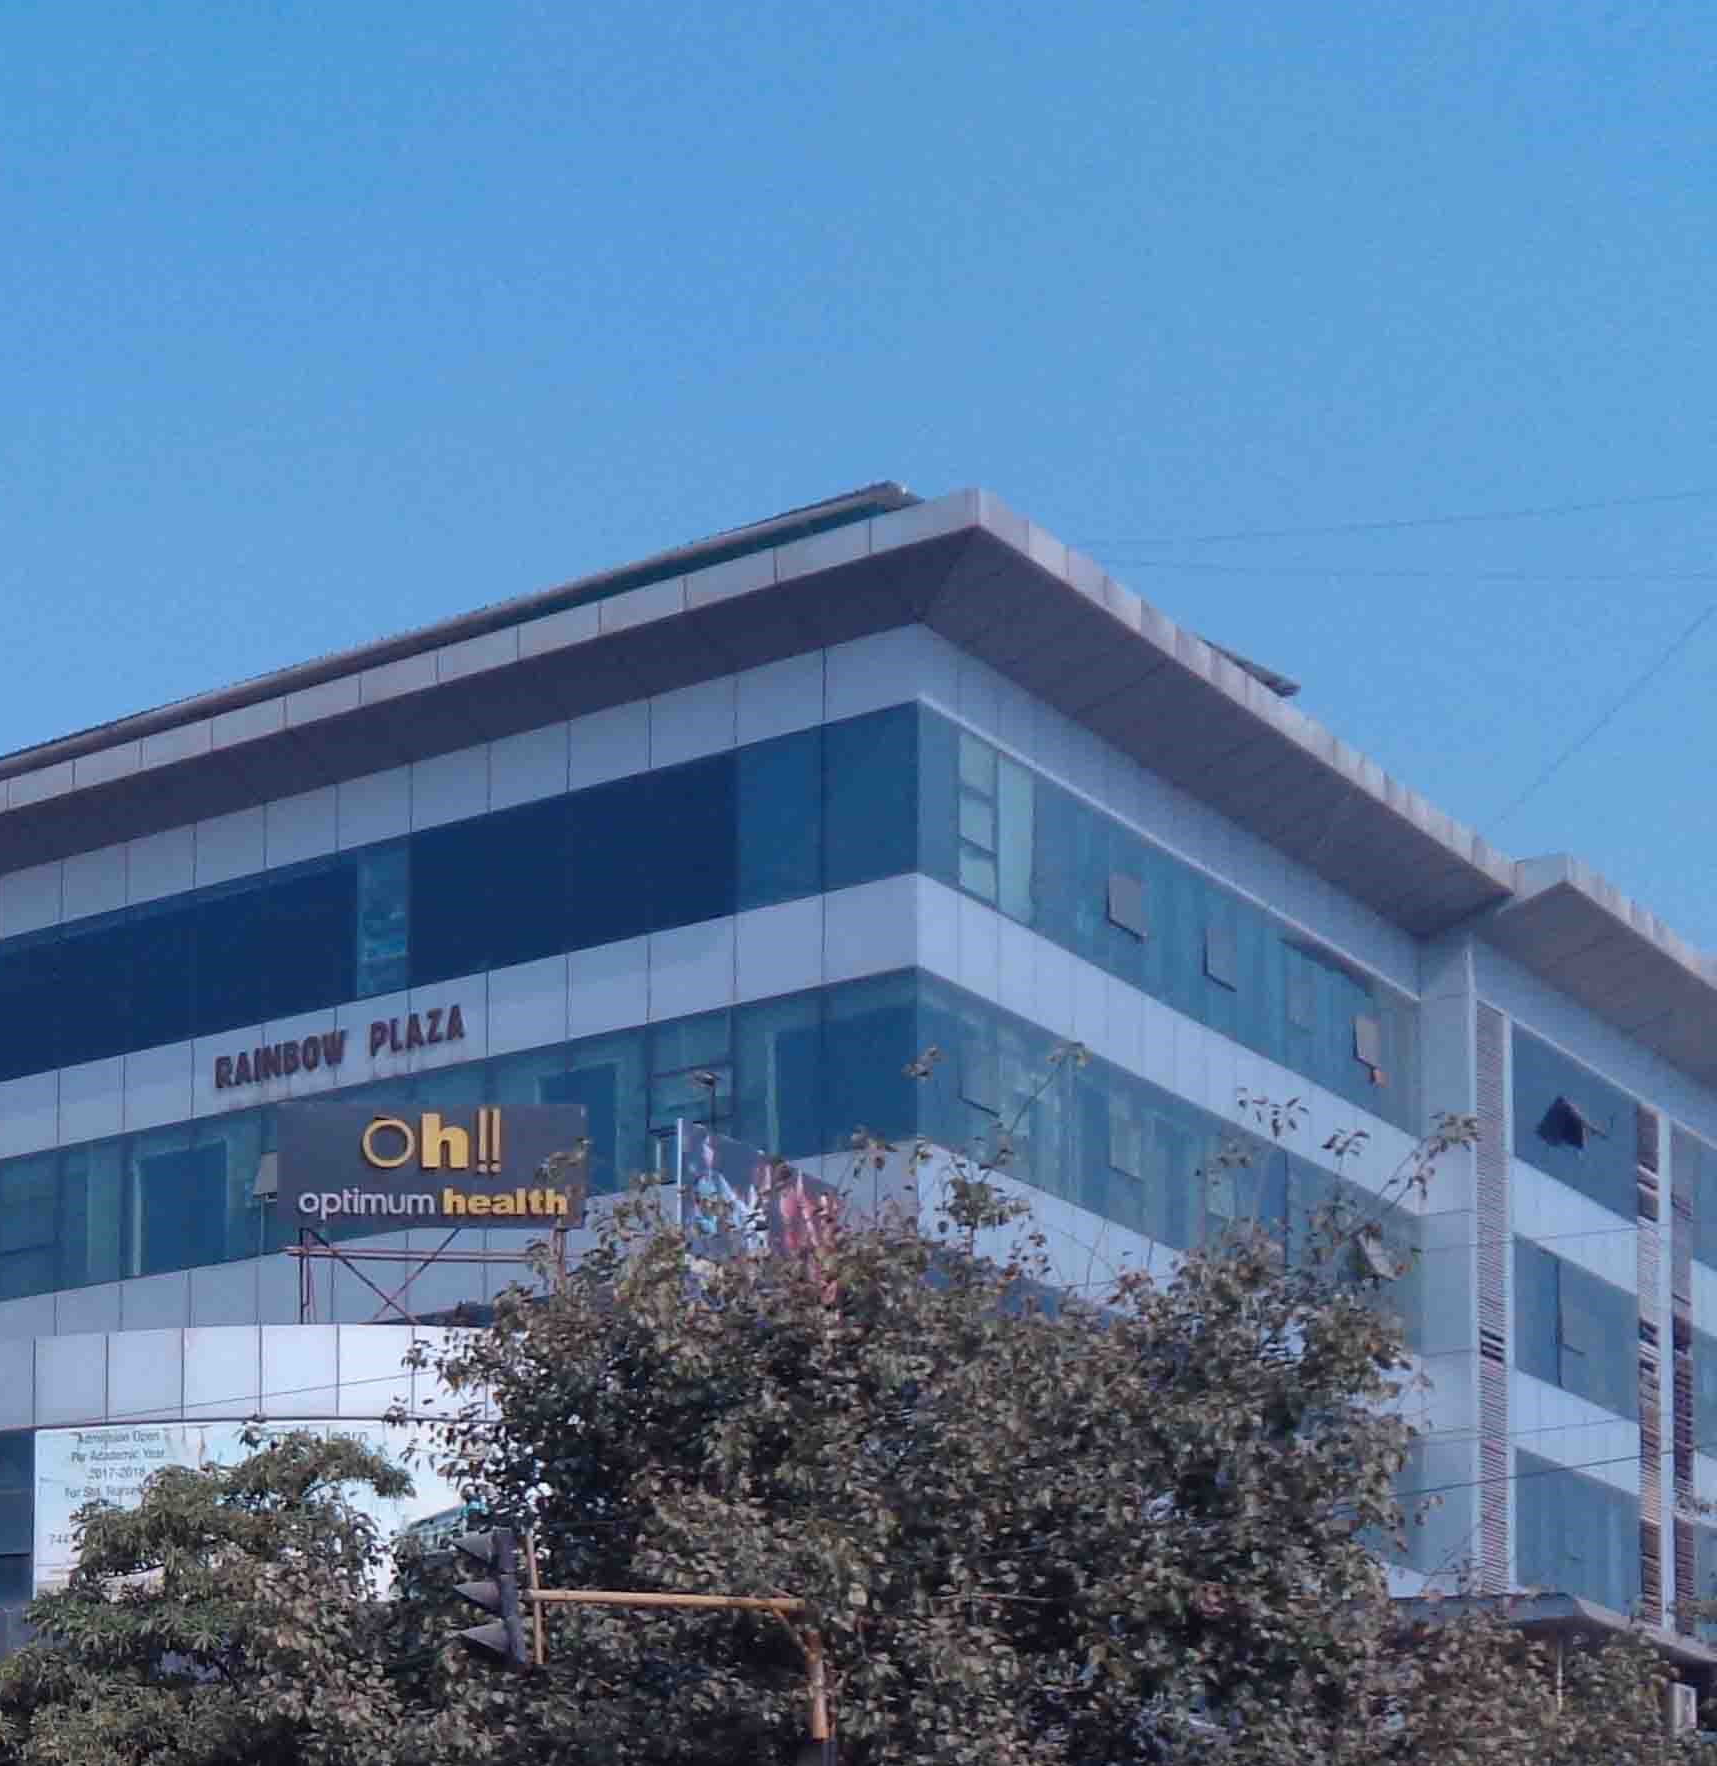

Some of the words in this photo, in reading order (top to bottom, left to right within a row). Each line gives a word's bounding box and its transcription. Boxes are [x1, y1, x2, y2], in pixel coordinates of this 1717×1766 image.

[214, 1030, 347, 1088] RAINBOW
[369, 1005, 464, 1056] PLAZA
[298, 1188, 435, 1219] optimum
[443, 1187, 568, 1217] health
